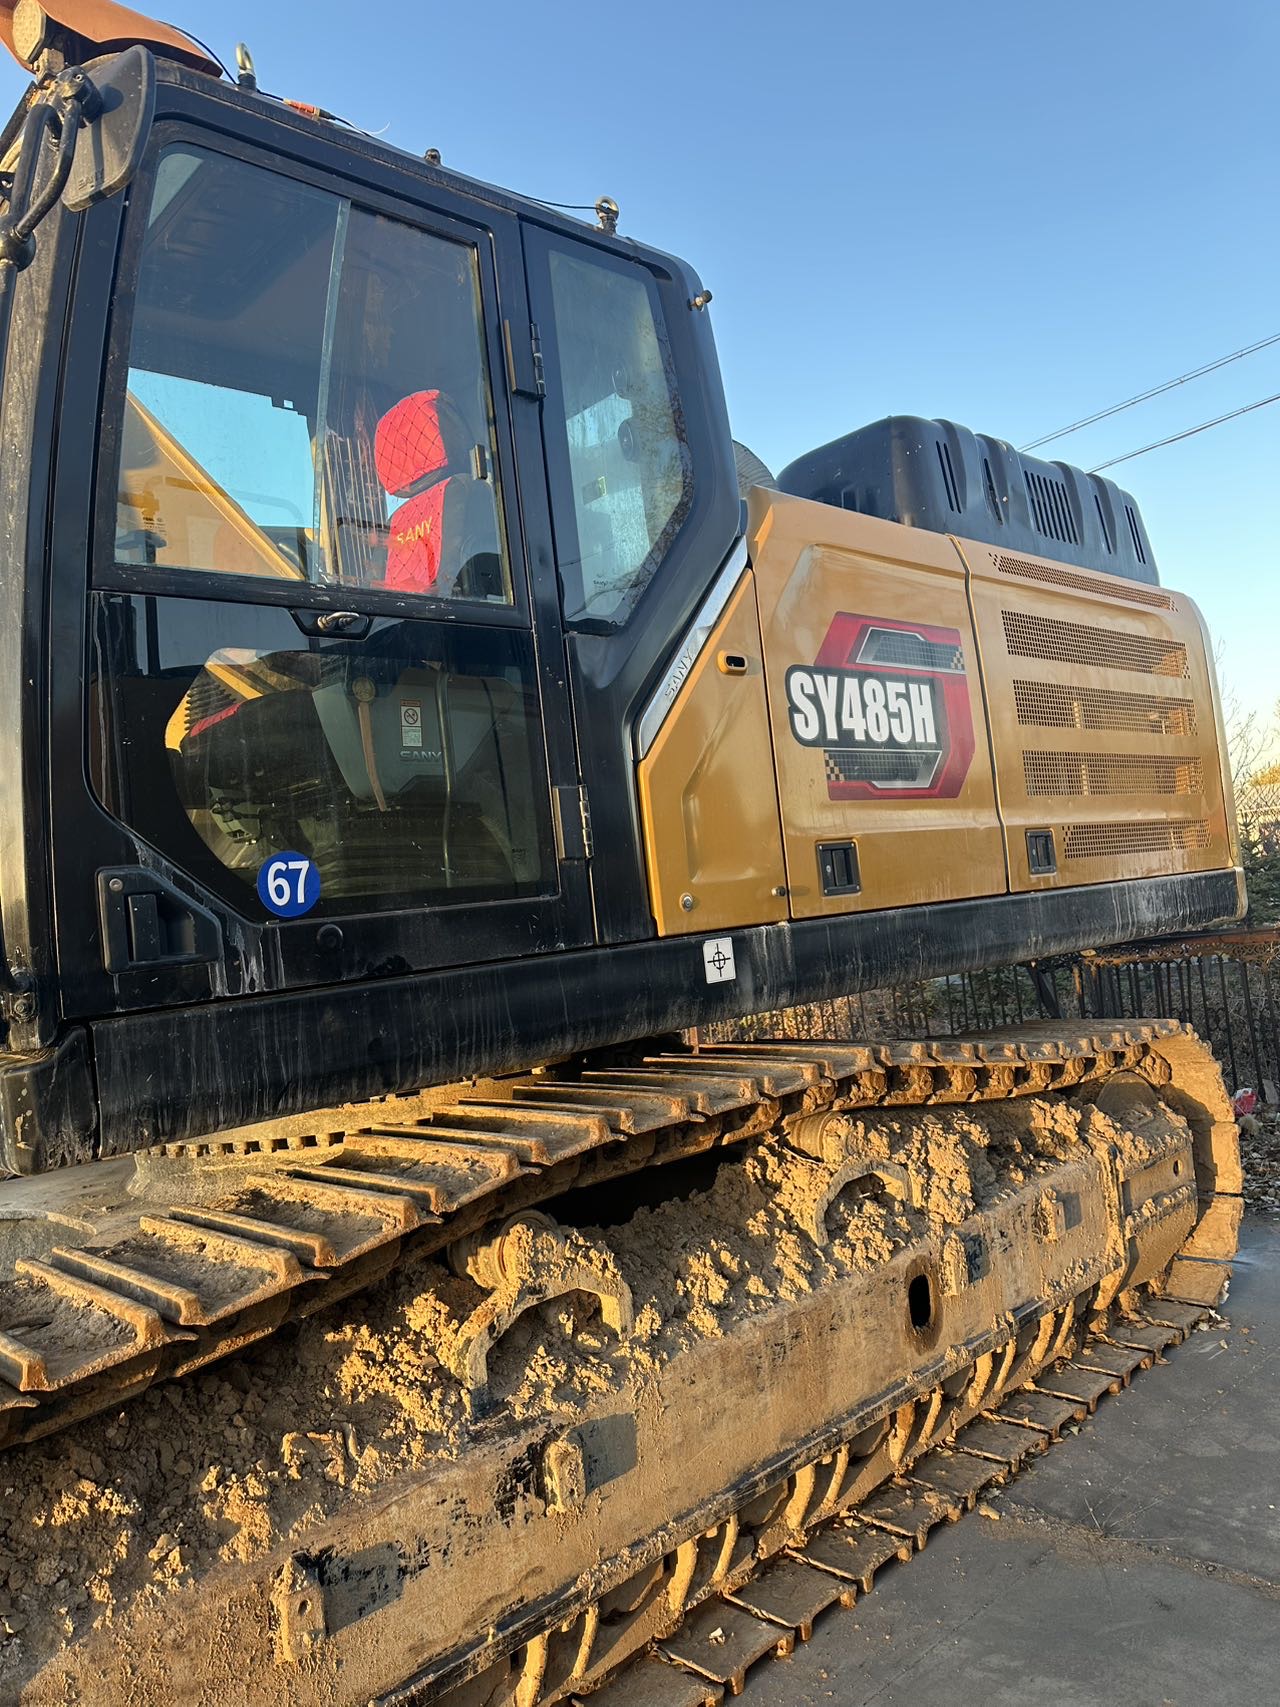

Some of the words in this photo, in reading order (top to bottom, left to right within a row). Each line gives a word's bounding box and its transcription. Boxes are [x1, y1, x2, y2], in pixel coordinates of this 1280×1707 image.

[397, 515, 433, 544] SANY
[664, 648, 693, 697] SANY
[789, 671, 937, 743] SY485H
[400, 750, 442, 760] SANY
[267, 860, 310, 906] 67
